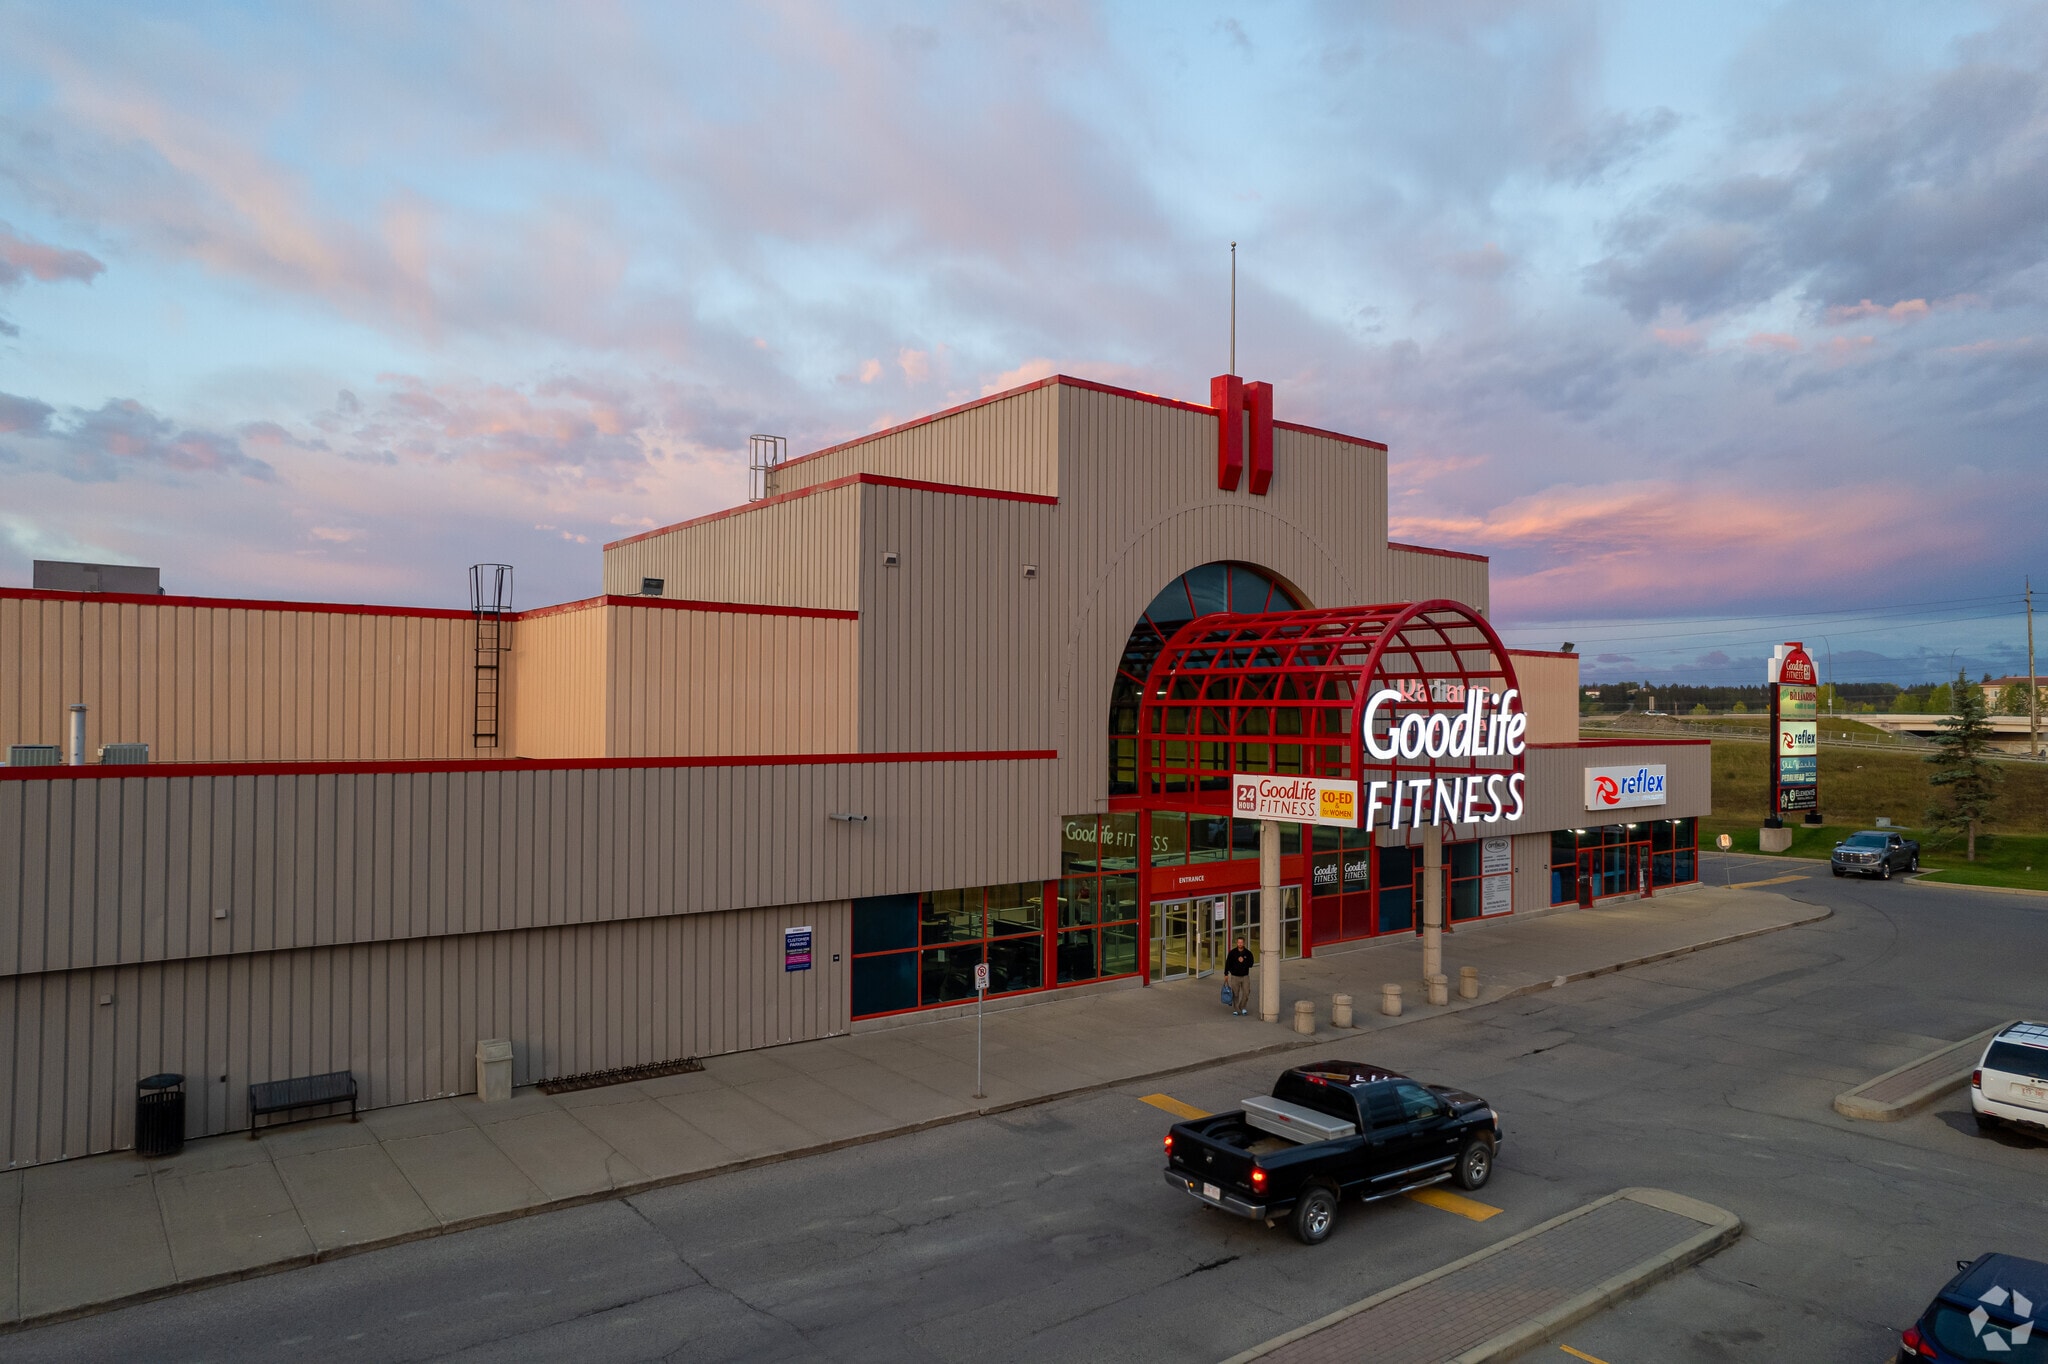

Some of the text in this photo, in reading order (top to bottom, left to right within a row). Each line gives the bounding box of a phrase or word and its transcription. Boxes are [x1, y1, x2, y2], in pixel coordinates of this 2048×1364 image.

[1786, 671, 1803, 680] FITNESS
[1363, 689, 1527, 760] GoodLife
[1794, 729, 1815, 744] reflex
[1621, 769, 1664, 794] reflex
[1239, 787, 1255, 801] 24
[1260, 779, 1317, 801] GoodLife
[1322, 791, 1352, 804] CO-ED
[1364, 773, 1526, 833] FITNESS
[1238, 801, 1255, 810] HOUR
[1260, 799, 1317, 817] FITNESS
[1330, 809, 1352, 817] WOMEN
[1066, 822, 1169, 852] Goodife FITSS
[1179, 875, 1205, 884] ENTRANCE
[1314, 873, 1338, 884] FITNESS
[1344, 870, 1368, 880] FITNESS
